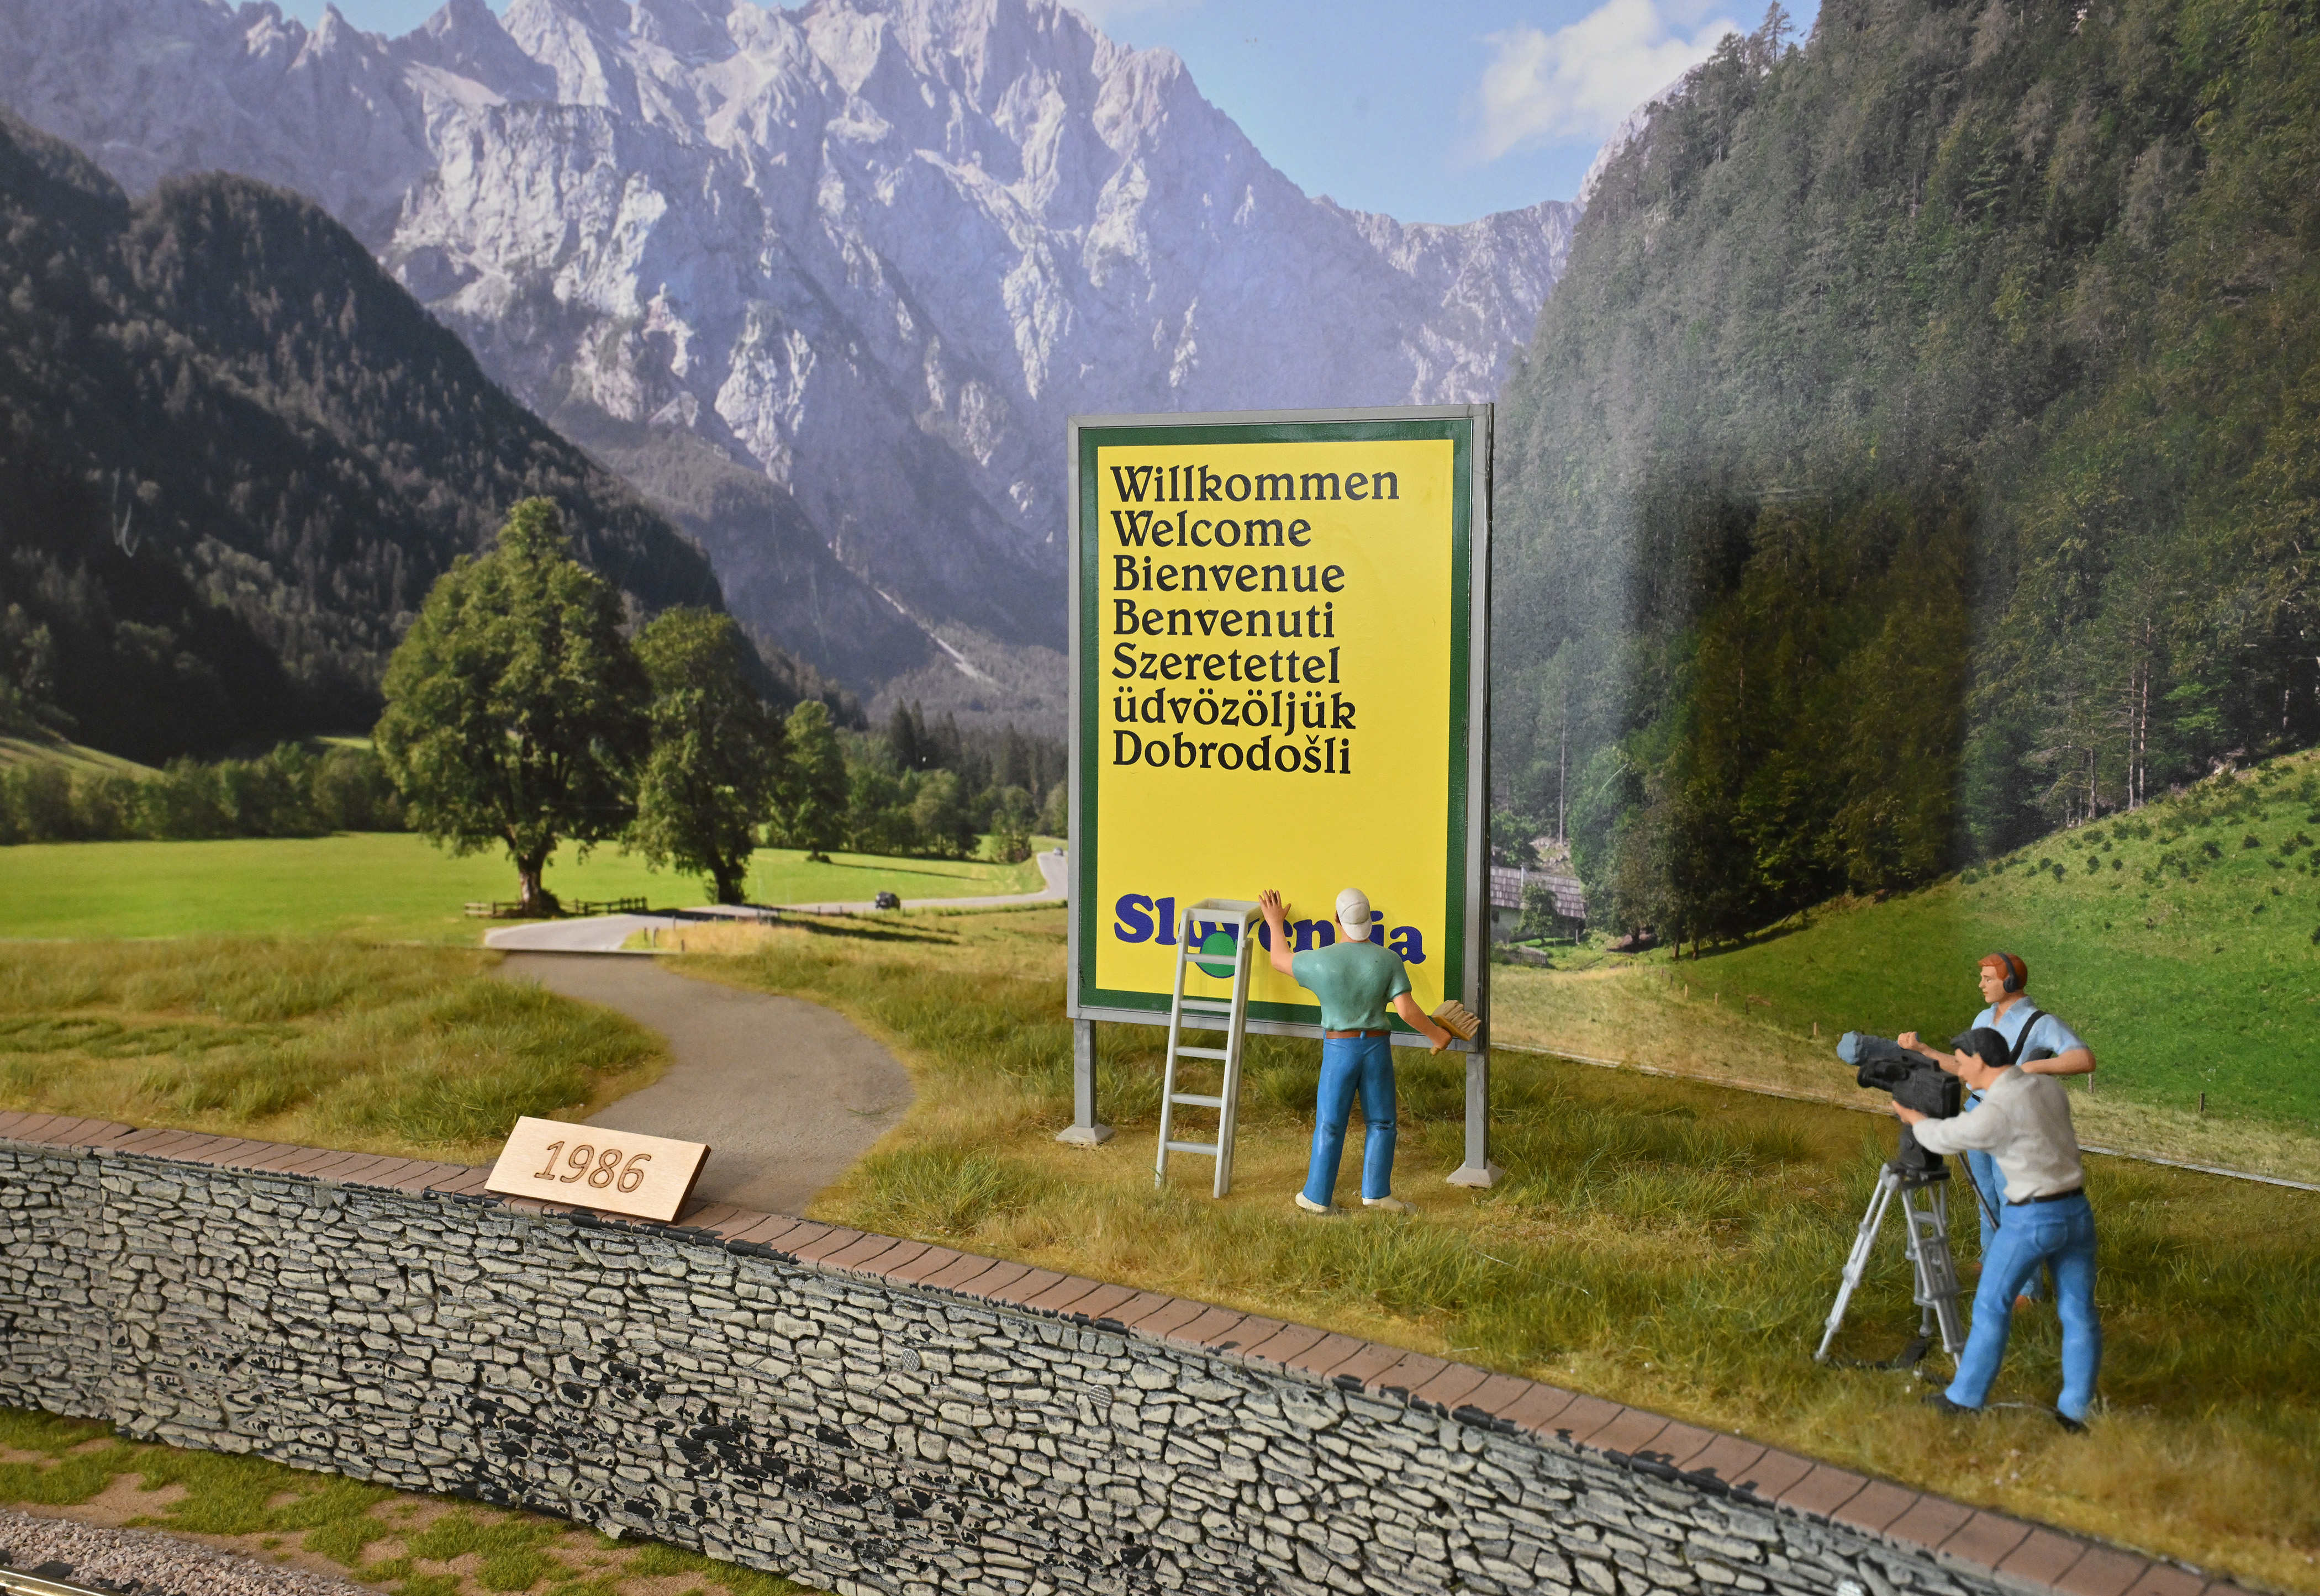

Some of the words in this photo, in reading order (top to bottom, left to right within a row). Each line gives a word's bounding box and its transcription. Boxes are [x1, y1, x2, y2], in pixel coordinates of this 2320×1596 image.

[1110, 465, 1399, 502] Willkommen
[1111, 510, 1311, 547] Welcome
[1114, 555, 1344, 593] Bienvenue
[1114, 599, 1334, 638] Benvenuti
[1112, 642, 1340, 683] Szeretettel
[1114, 686, 1356, 736] üdvözöljük
[1114, 730, 1351, 773] Dobrodošli
[534, 1141, 652, 1193] 1986
